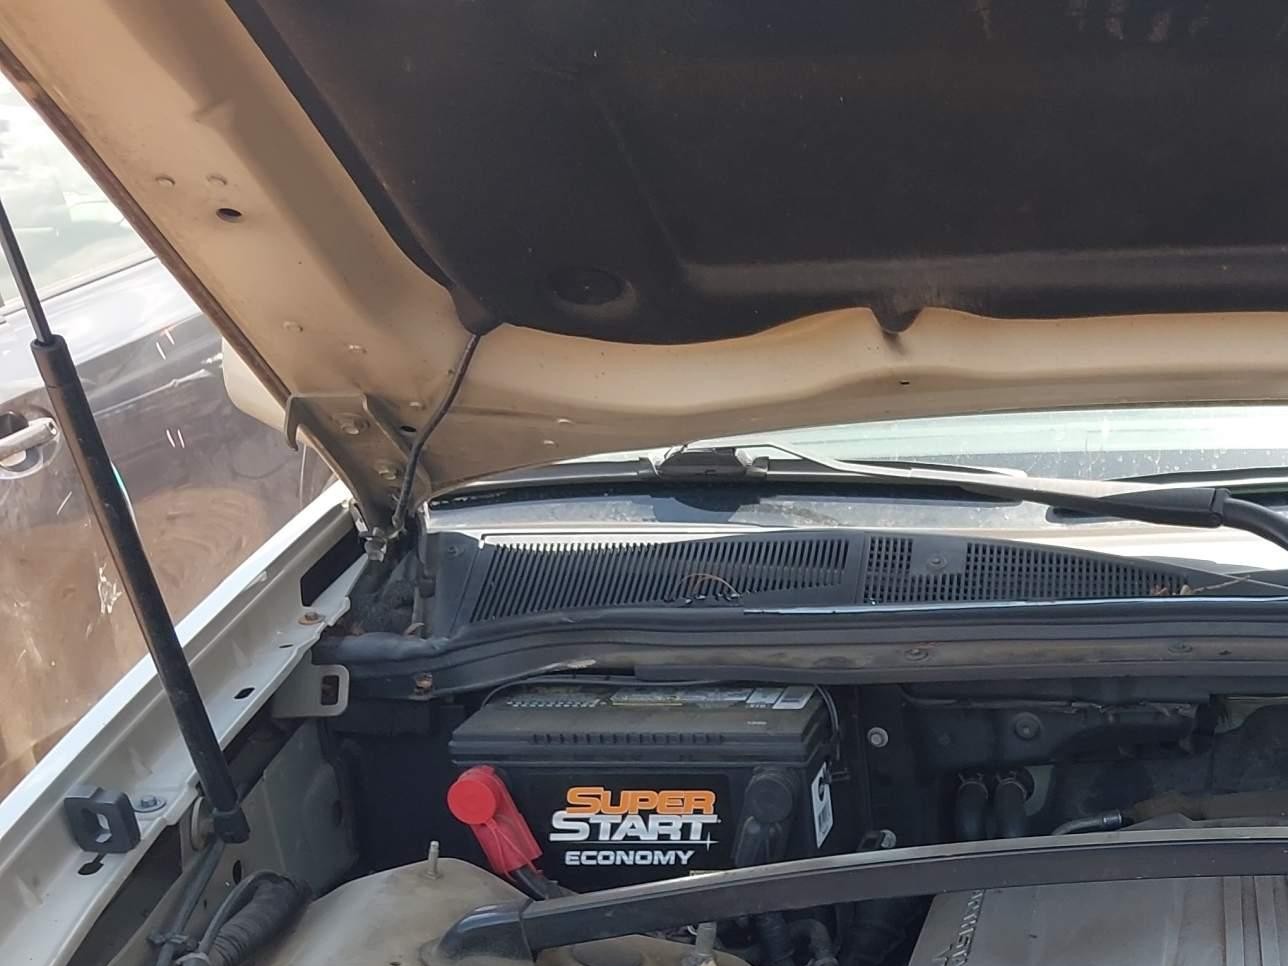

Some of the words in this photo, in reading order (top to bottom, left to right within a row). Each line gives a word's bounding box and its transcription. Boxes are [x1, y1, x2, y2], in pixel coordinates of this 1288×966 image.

[566, 787, 716, 814] SUPER
[550, 811, 719, 841] START
[565, 851, 695, 865] ECONOMY
